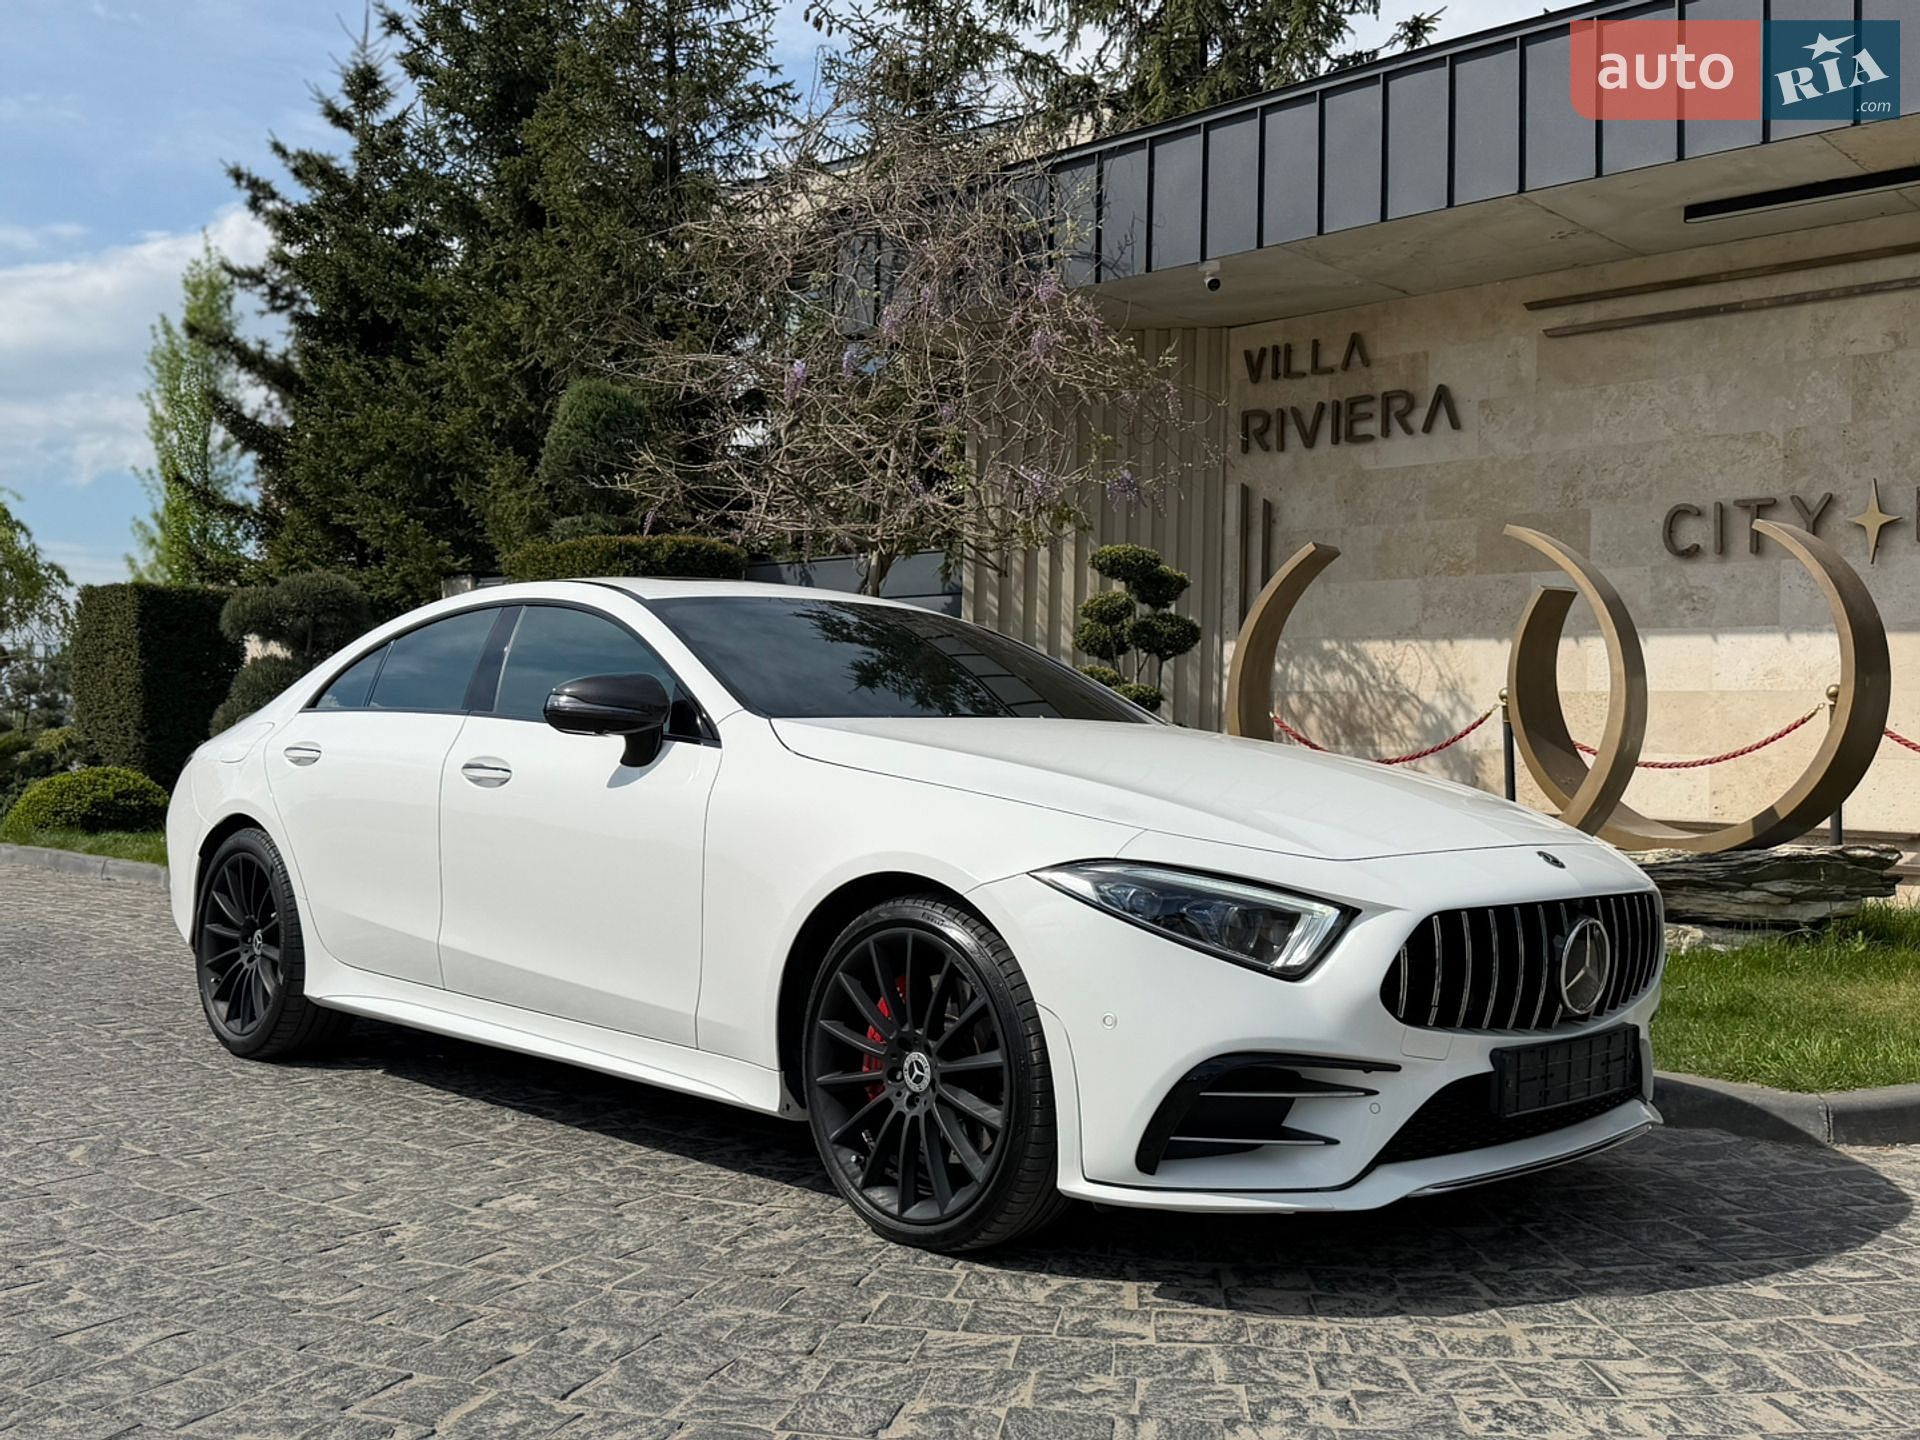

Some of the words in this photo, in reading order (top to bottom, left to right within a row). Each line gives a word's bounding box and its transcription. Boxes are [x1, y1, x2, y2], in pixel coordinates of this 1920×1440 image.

[1244, 332, 1371, 384] VILLA
[1240, 384, 1462, 454] RIVIERA
[1662, 492, 1833, 557] CITY
